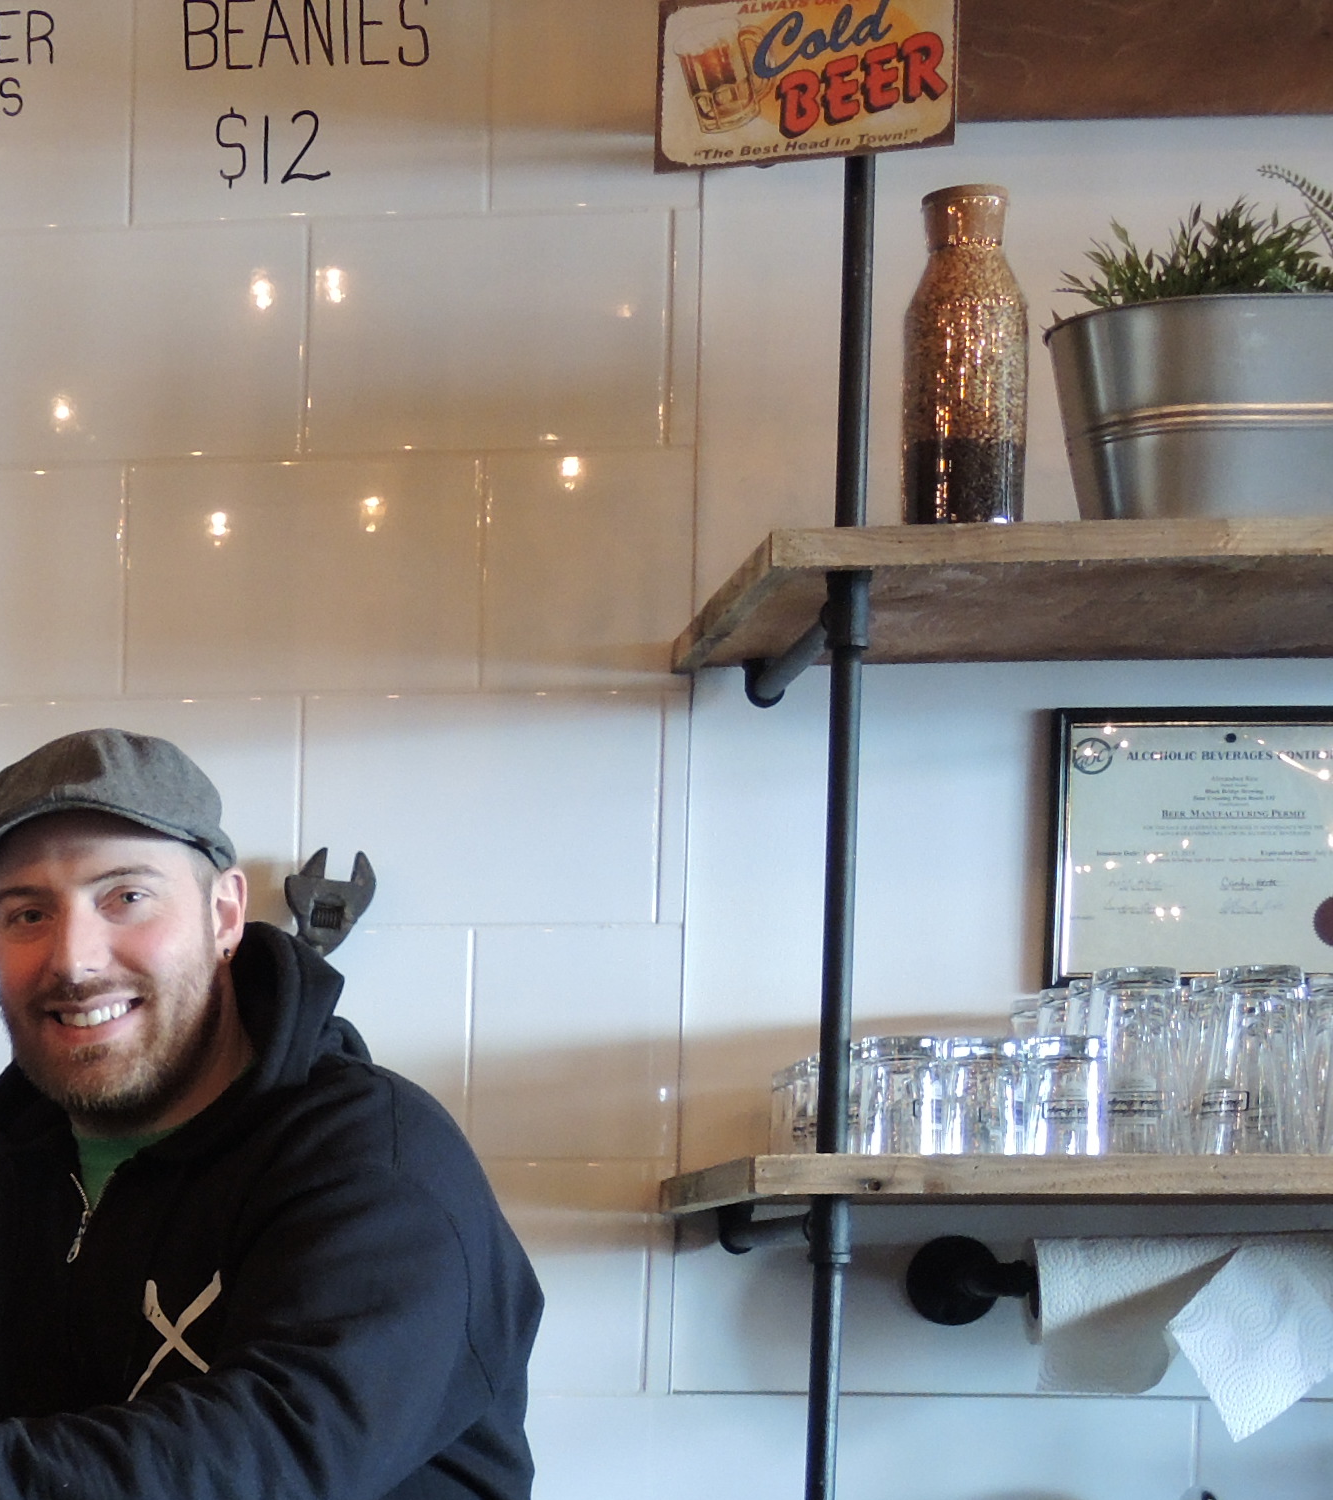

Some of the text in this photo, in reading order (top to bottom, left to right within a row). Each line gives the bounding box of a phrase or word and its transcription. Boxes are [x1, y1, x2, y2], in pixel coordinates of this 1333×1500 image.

[183, 0, 430, 71] BEANIES
[752, 0, 893, 79] Cold
[775, 31, 948, 139] BEER
[215, 106, 332, 188] $12
[740, 143, 779, 157] Best
[784, 136, 830, 152] Head
[835, 136, 851, 146] in
[1201, 751, 1273, 760] BEVERAGES
